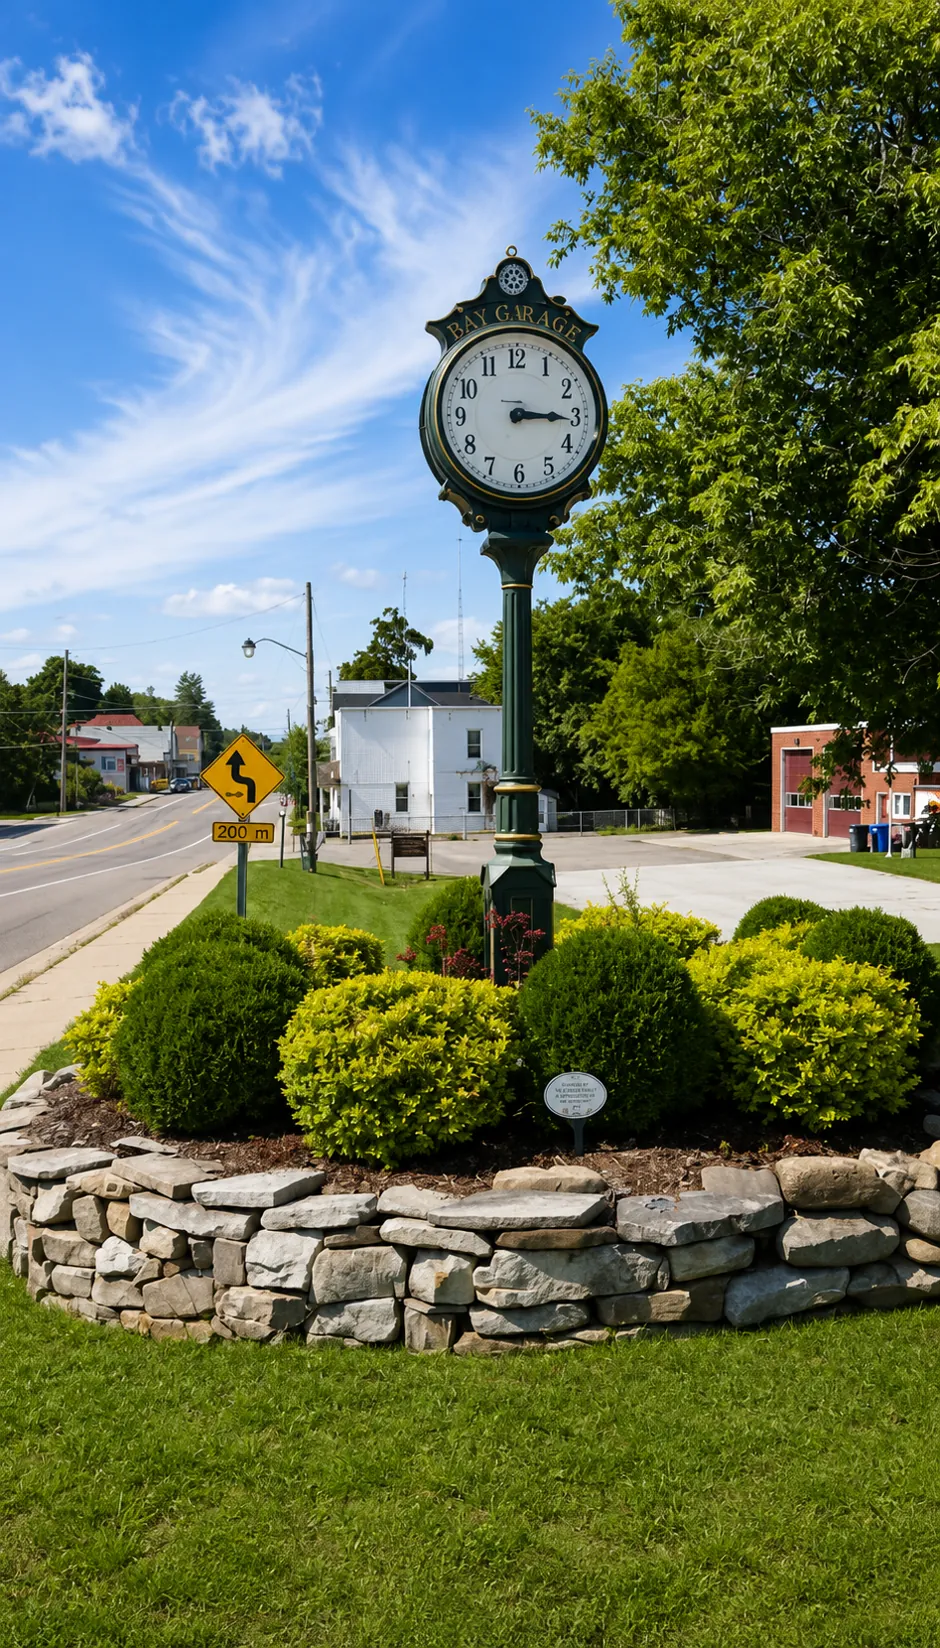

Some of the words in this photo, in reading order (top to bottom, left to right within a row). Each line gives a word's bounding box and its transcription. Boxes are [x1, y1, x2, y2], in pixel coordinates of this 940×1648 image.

[447, 308, 488, 340] BAY
[495, 304, 582, 342] GARAGE
[481, 356, 497, 376] 11
[508, 348, 526, 369] 12
[542, 356, 549, 376] 1
[460, 378, 477, 399] 10
[561, 378, 572, 399] 2
[455, 406, 466, 427] 9
[570, 407, 580, 427] 3
[464, 434, 476, 454] 8
[561, 433, 573, 453] 4
[484, 457, 495, 475] 7
[513, 463, 525, 483] 6
[543, 457, 554, 476] 5
[217, 825, 247, 838] 200
[255, 829, 269, 839] m
